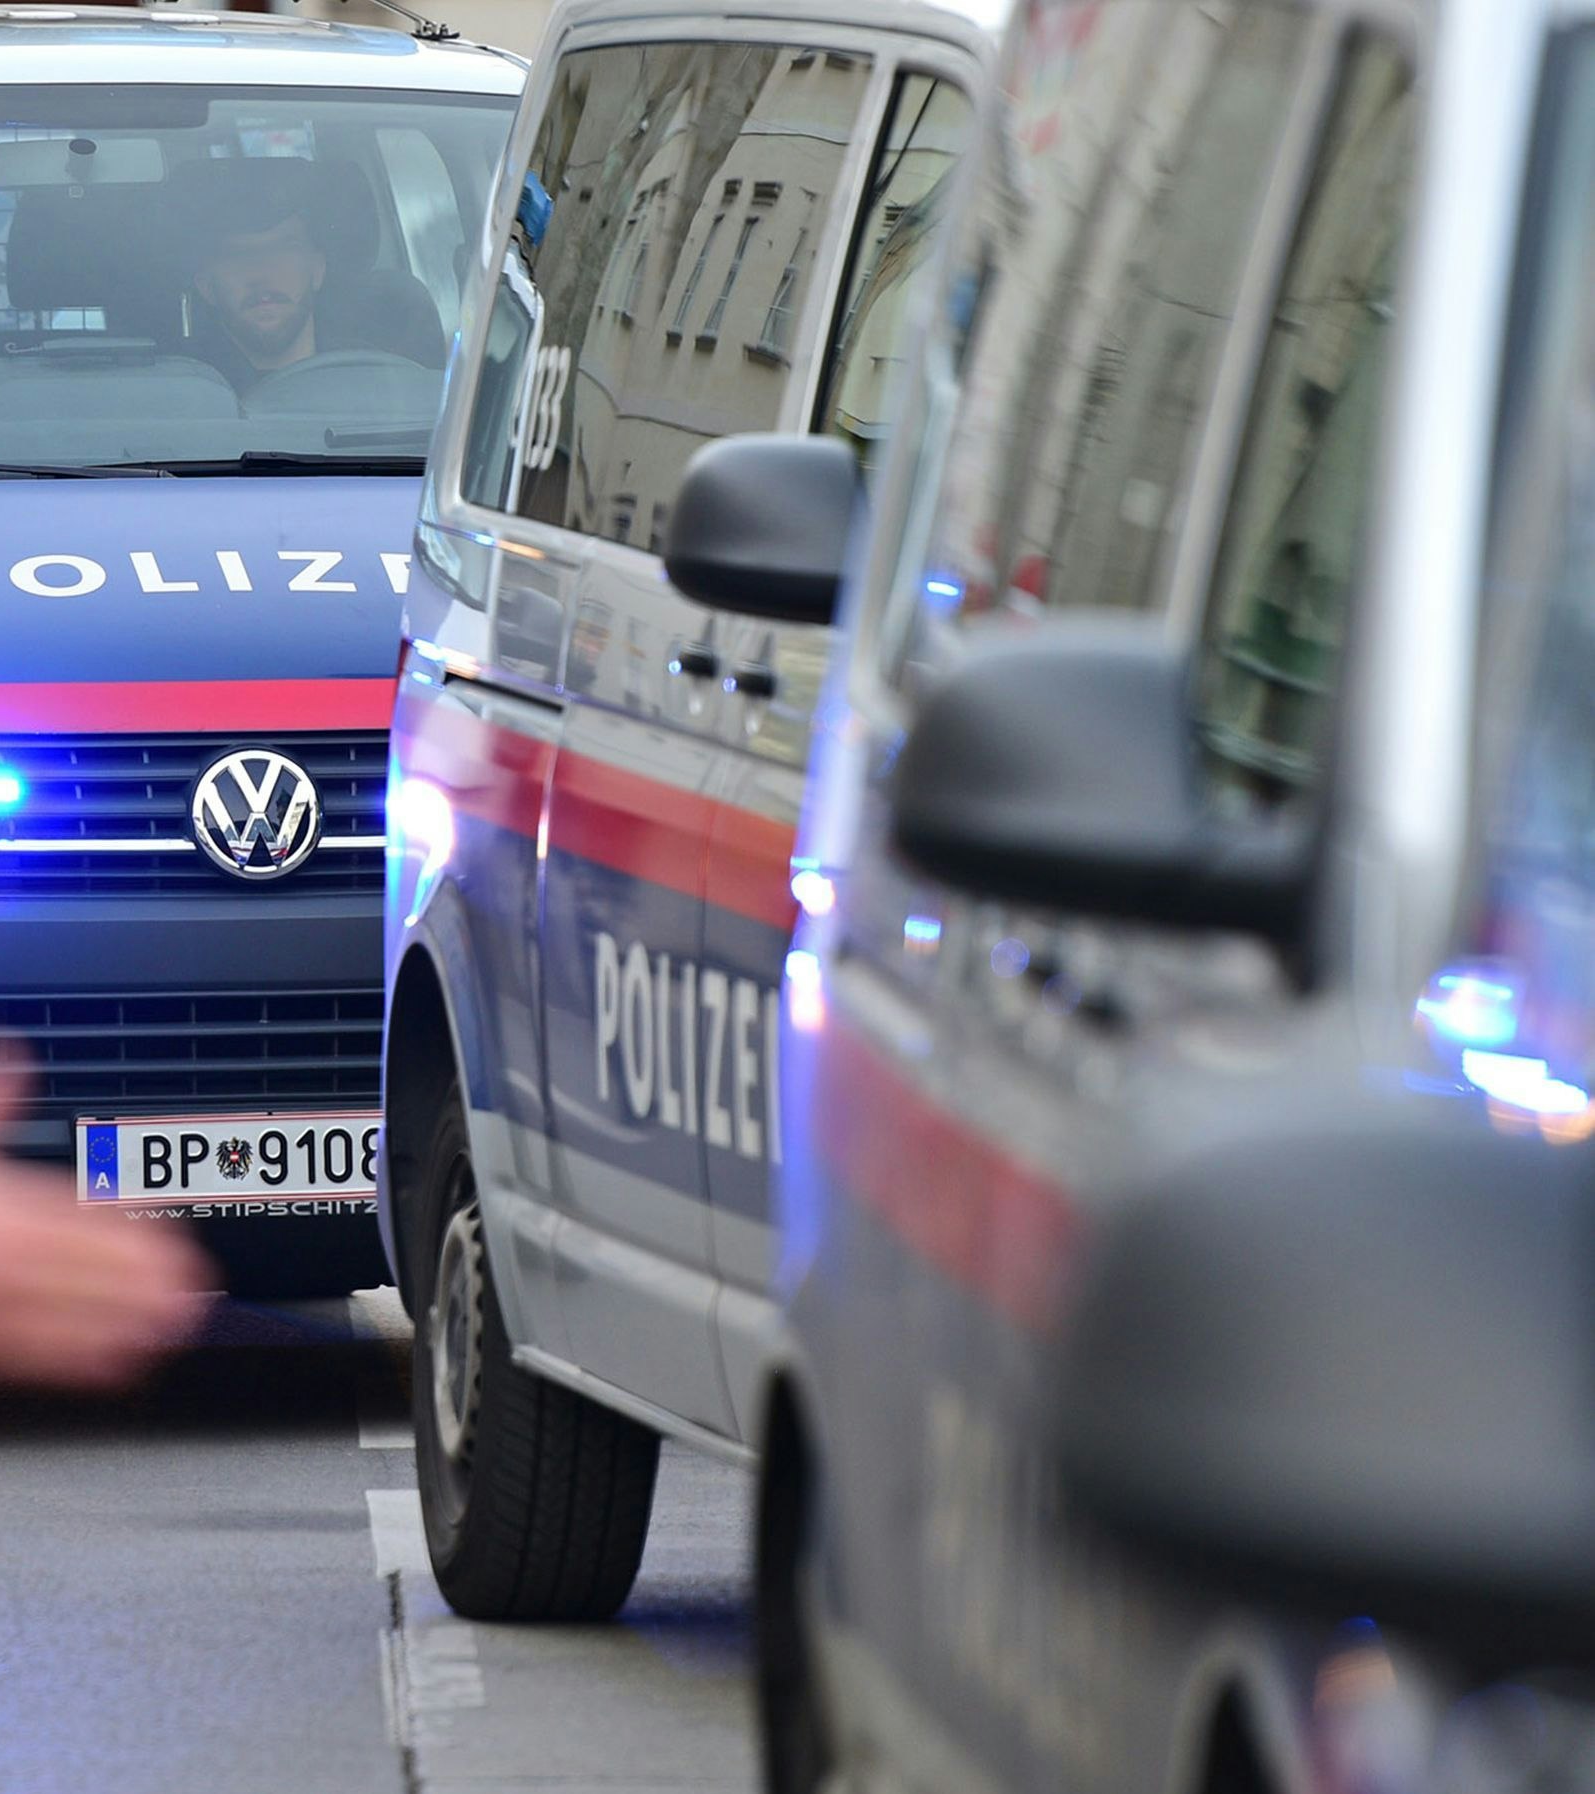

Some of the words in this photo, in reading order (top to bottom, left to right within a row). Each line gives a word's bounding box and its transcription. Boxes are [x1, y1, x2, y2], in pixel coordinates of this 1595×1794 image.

[594, 930, 784, 1166] POLIZEI
[94, 1172, 111, 1190] A
[142, 1132, 209, 1189] BP
